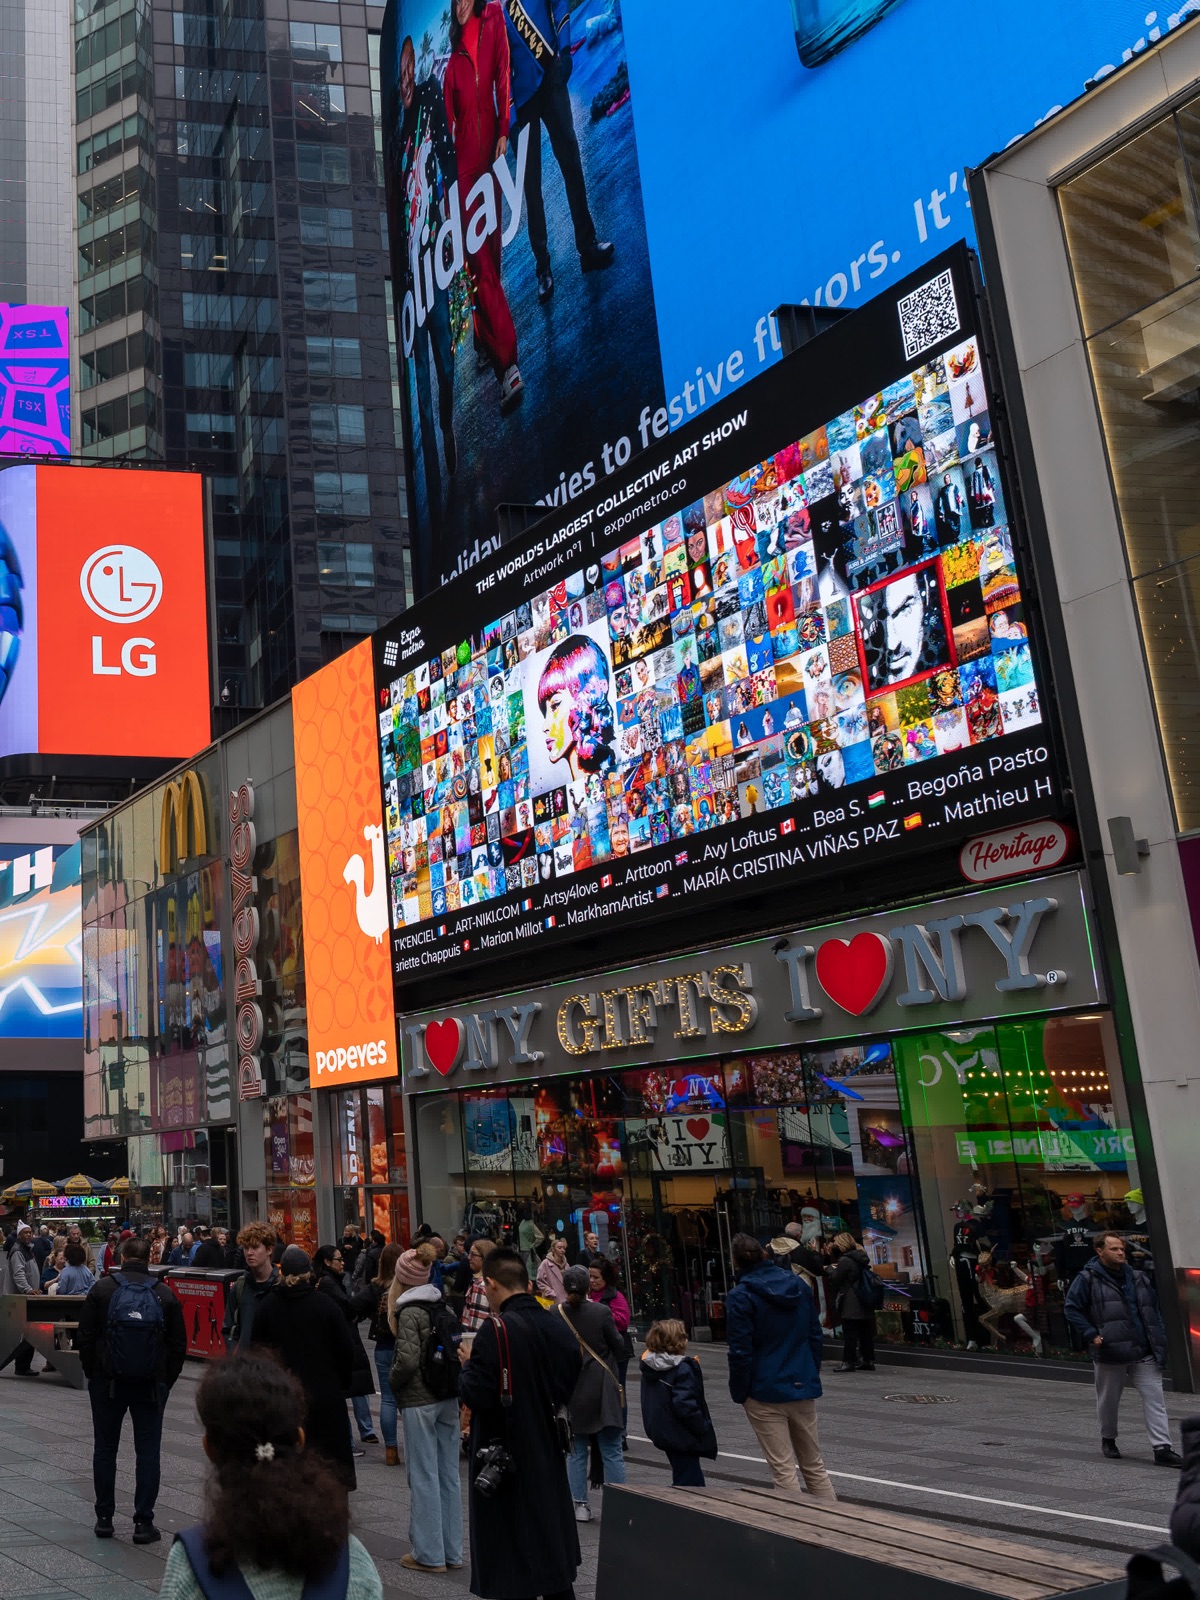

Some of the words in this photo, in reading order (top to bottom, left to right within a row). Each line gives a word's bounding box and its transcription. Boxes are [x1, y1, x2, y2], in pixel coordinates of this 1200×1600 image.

[601, 435, 631, 475] to
[638, 349, 745, 449] festive
[753, 239, 901, 362] flvors.
[18, 399, 42, 413] TSX
[475, 575, 498, 594] THE
[496, 541, 544, 578] WORLD'S
[545, 509, 595, 551] LARGEST
[596, 460, 671, 518] COLLECTIVE
[672, 441, 701, 476] ART
[702, 410, 749, 451] SHOW
[523, 552, 564, 587] Artwork
[603, 478, 687, 537] expometro.co
[400, 626, 421, 645] Expo
[401, 638, 425, 660] metro
[91, 636, 157, 677] LG
[455, 903, 520, 935] ART-NIKI.COM
[542, 880, 599, 909] Artsy4love
[625, 858, 673, 884] Arttoon
[703, 842, 729, 862] Avy
[731, 827, 777, 854] Loftus
[813, 806, 846, 829] Bea
[849, 799, 865, 818] S.
[908, 765, 984, 801] Begoña
[989, 746, 1048, 777] Pasto
[968, 830, 1058, 873] Heritage
[420, 943, 461, 965] Chappuis
[480, 929, 513, 950] Marion
[515, 920, 544, 942] Millot
[566, 889, 654, 925] MarkhamArtist
[683, 866, 731, 894] MARÍA
[732, 847, 805, 880] CRISTINA
[806, 831, 859, 860] VIÑAS
[863, 818, 901, 845] PAZ
[944, 786, 1029, 824] Mathieu
[1035, 775, 1052, 799] H
[405, 1023, 430, 1077] I
[556, 962, 759, 1056] GIFTS
[774, 945, 824, 1024] I
[665, 1080, 676, 1098] I
[688, 1076, 714, 1096] NY
[672, 1119, 686, 1141] I
[671, 1142, 717, 1167] NY
[73, 1196, 102, 1207] GYRO
